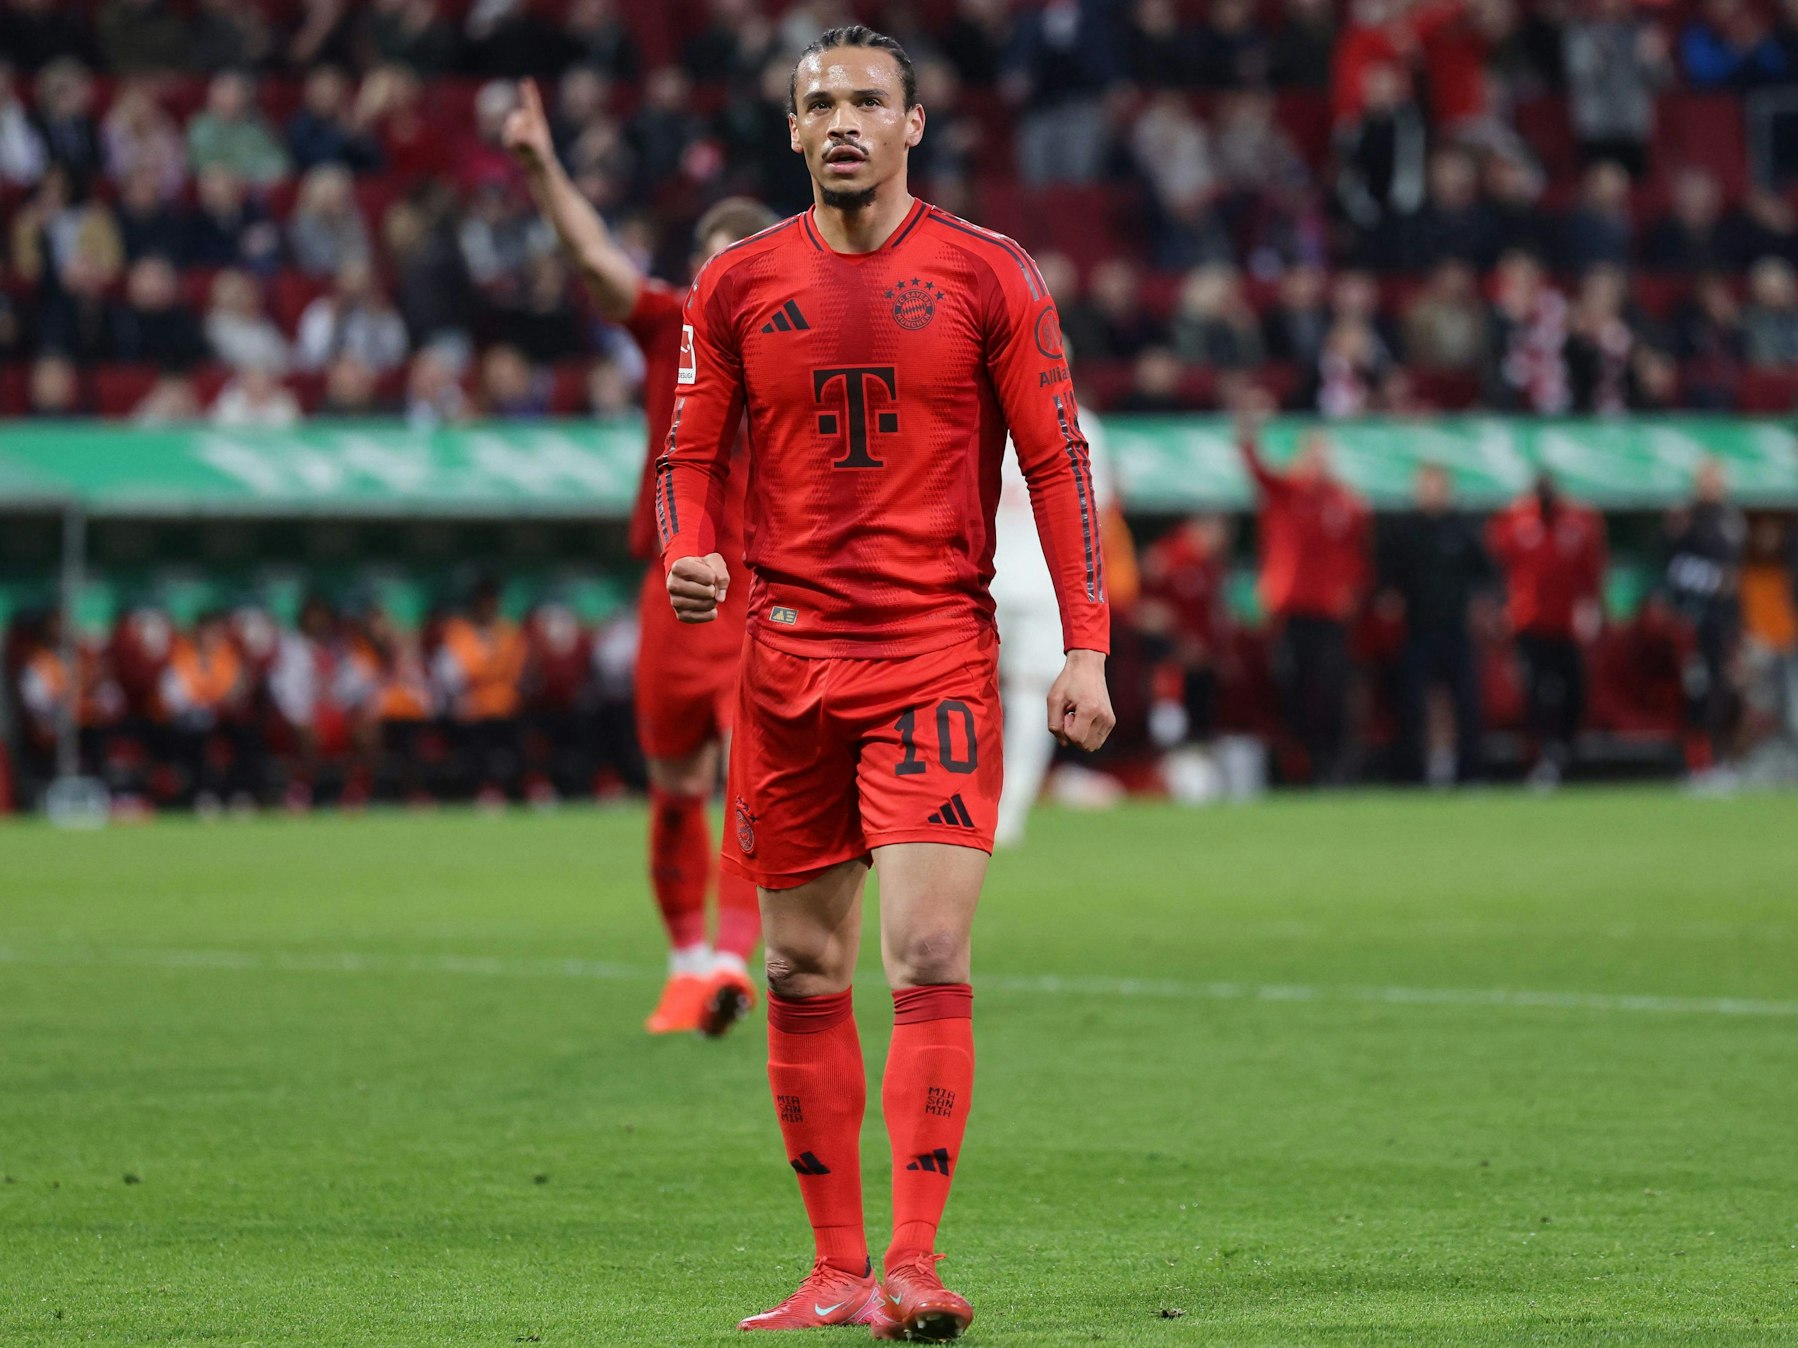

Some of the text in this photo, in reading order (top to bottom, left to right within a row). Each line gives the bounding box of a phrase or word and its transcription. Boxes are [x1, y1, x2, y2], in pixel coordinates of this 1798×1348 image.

[905, 292, 931, 307] BAYERN
[813, 367, 898, 468] T
[894, 700, 978, 775] 10
[777, 1095, 801, 1104] MIA
[928, 1087, 956, 1100] MIA
[778, 1103, 802, 1113] SAN
[927, 1096, 954, 1109] SAN
[781, 1112, 804, 1123] MIA
[925, 1104, 951, 1118] MIA
